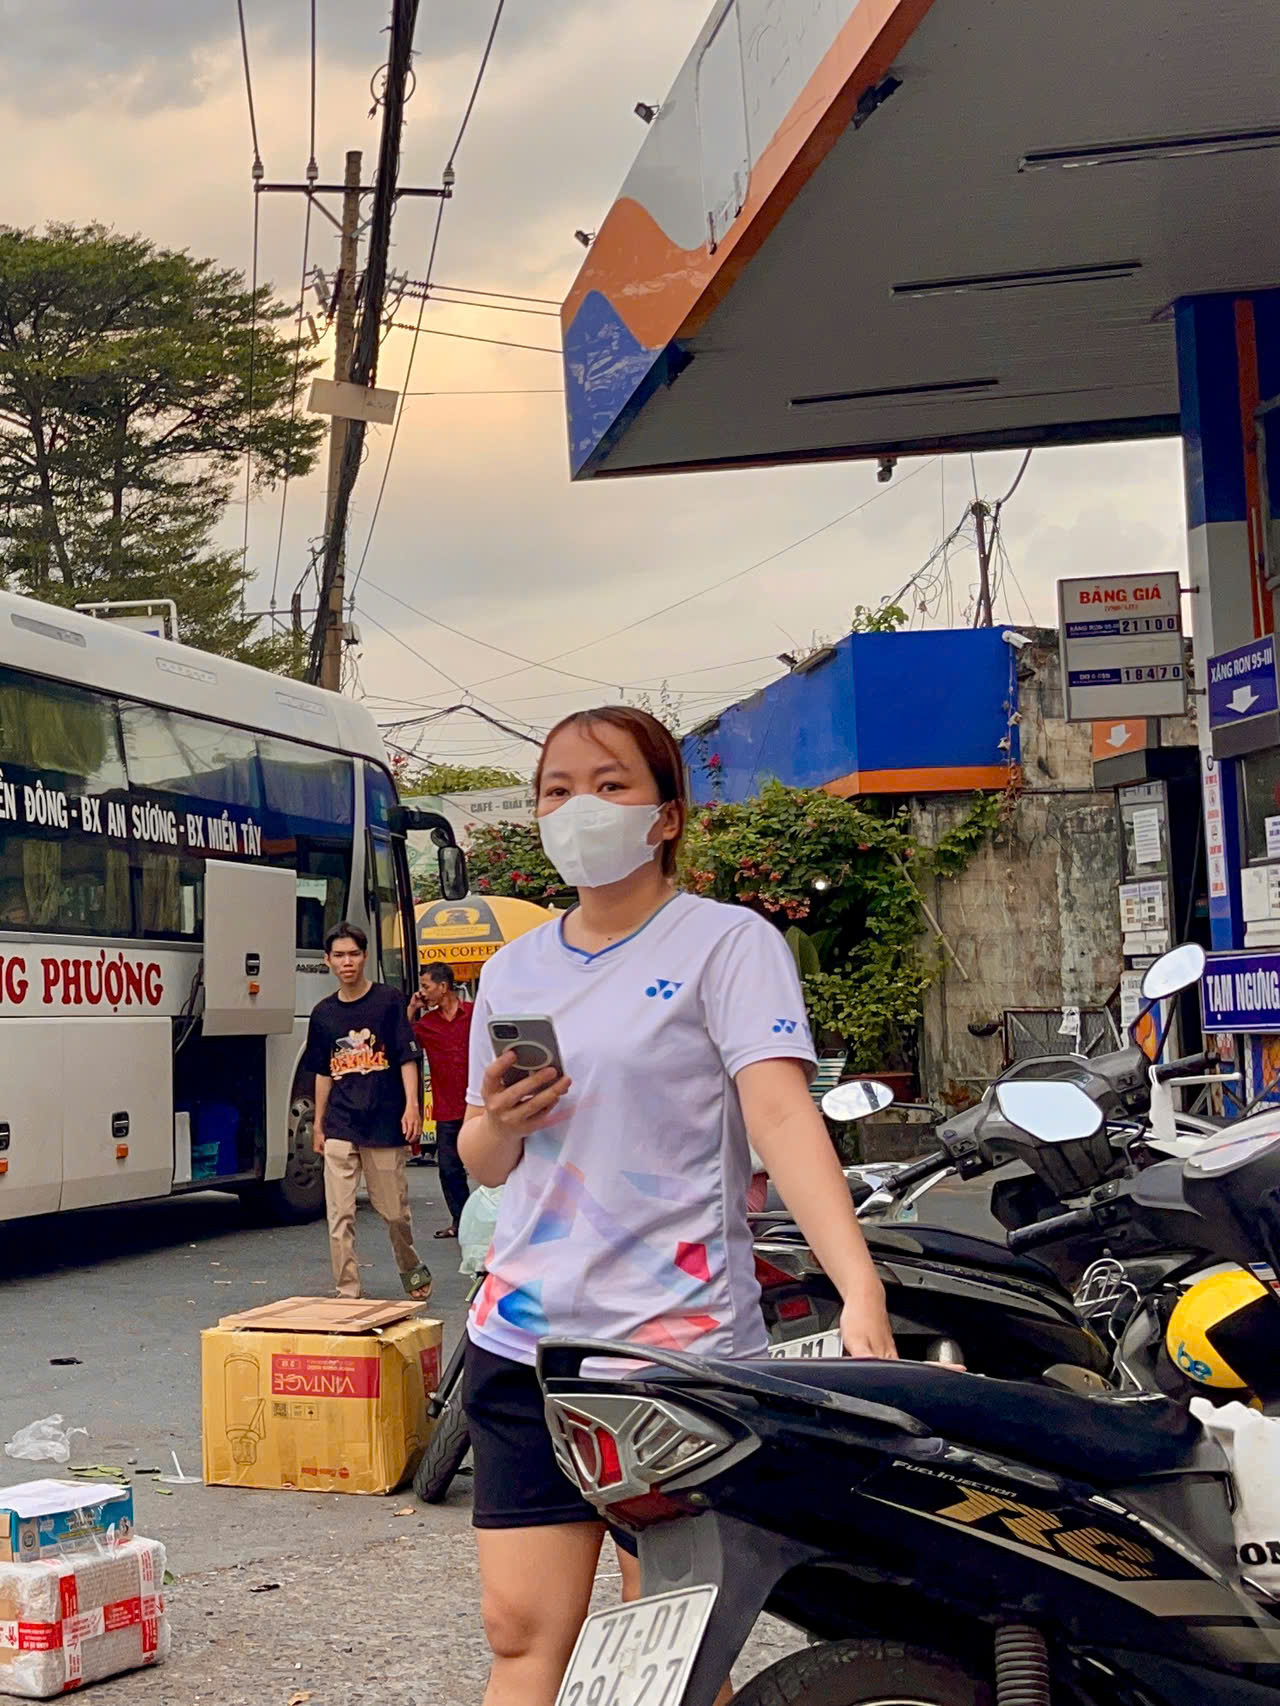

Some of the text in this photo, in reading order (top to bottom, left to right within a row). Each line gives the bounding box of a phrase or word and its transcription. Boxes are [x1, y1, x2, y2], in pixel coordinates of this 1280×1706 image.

[1133, 583, 1162, 601] GIÁ
[1233, 655, 1251, 676] RON
[24, 780, 68, 829] ĐÔNG
[81, 796, 102, 834] BX
[108, 801, 127, 838] AN
[132, 801, 178, 845] SƯƠNG
[186, 813, 206, 848] BX
[207, 809, 238, 853] MIỀN
[240, 817, 262, 856] TÂY
[41, 949, 164, 1013] PHƯỢNG
